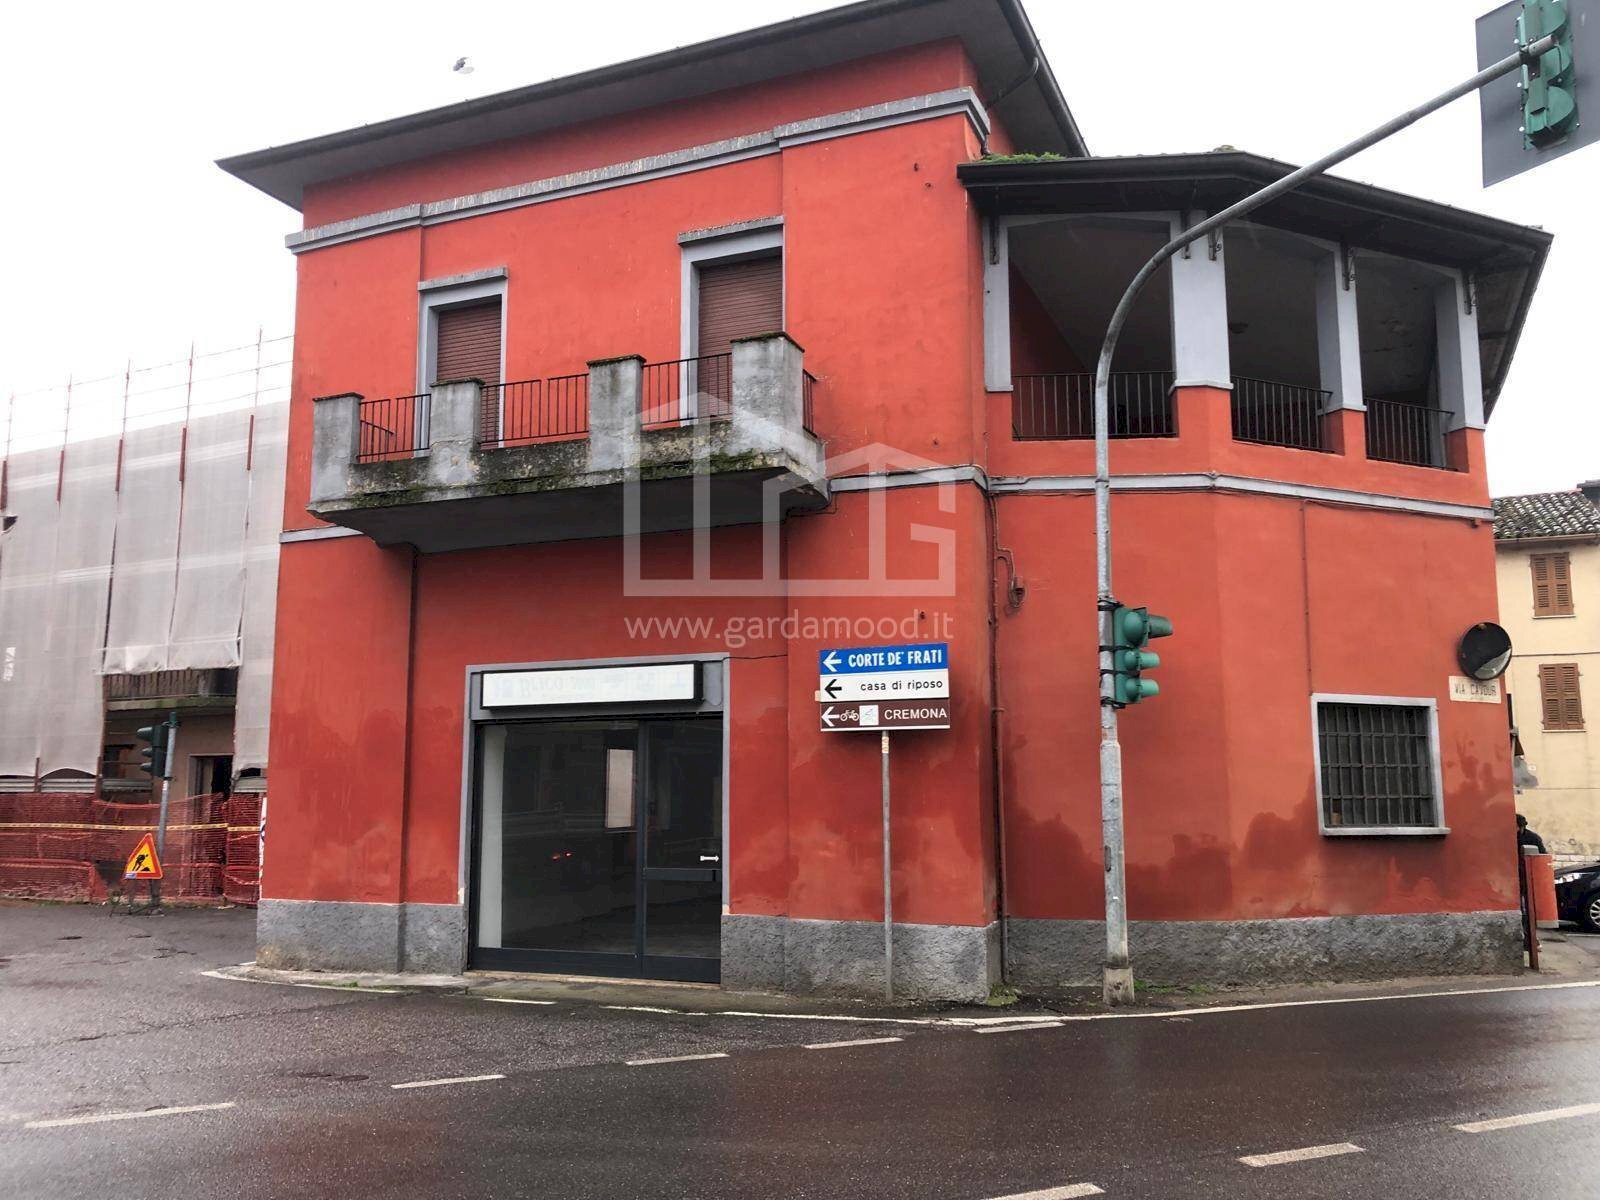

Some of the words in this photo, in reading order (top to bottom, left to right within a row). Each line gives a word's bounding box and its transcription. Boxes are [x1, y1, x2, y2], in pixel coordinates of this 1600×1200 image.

[848, 653, 885, 668] CORTE
[907, 649, 942, 665] FRATI
[860, 682, 886, 691] casa
[891, 681, 902, 691] di
[907, 679, 943, 691] riposo
[884, 708, 947, 720] CREMONA
